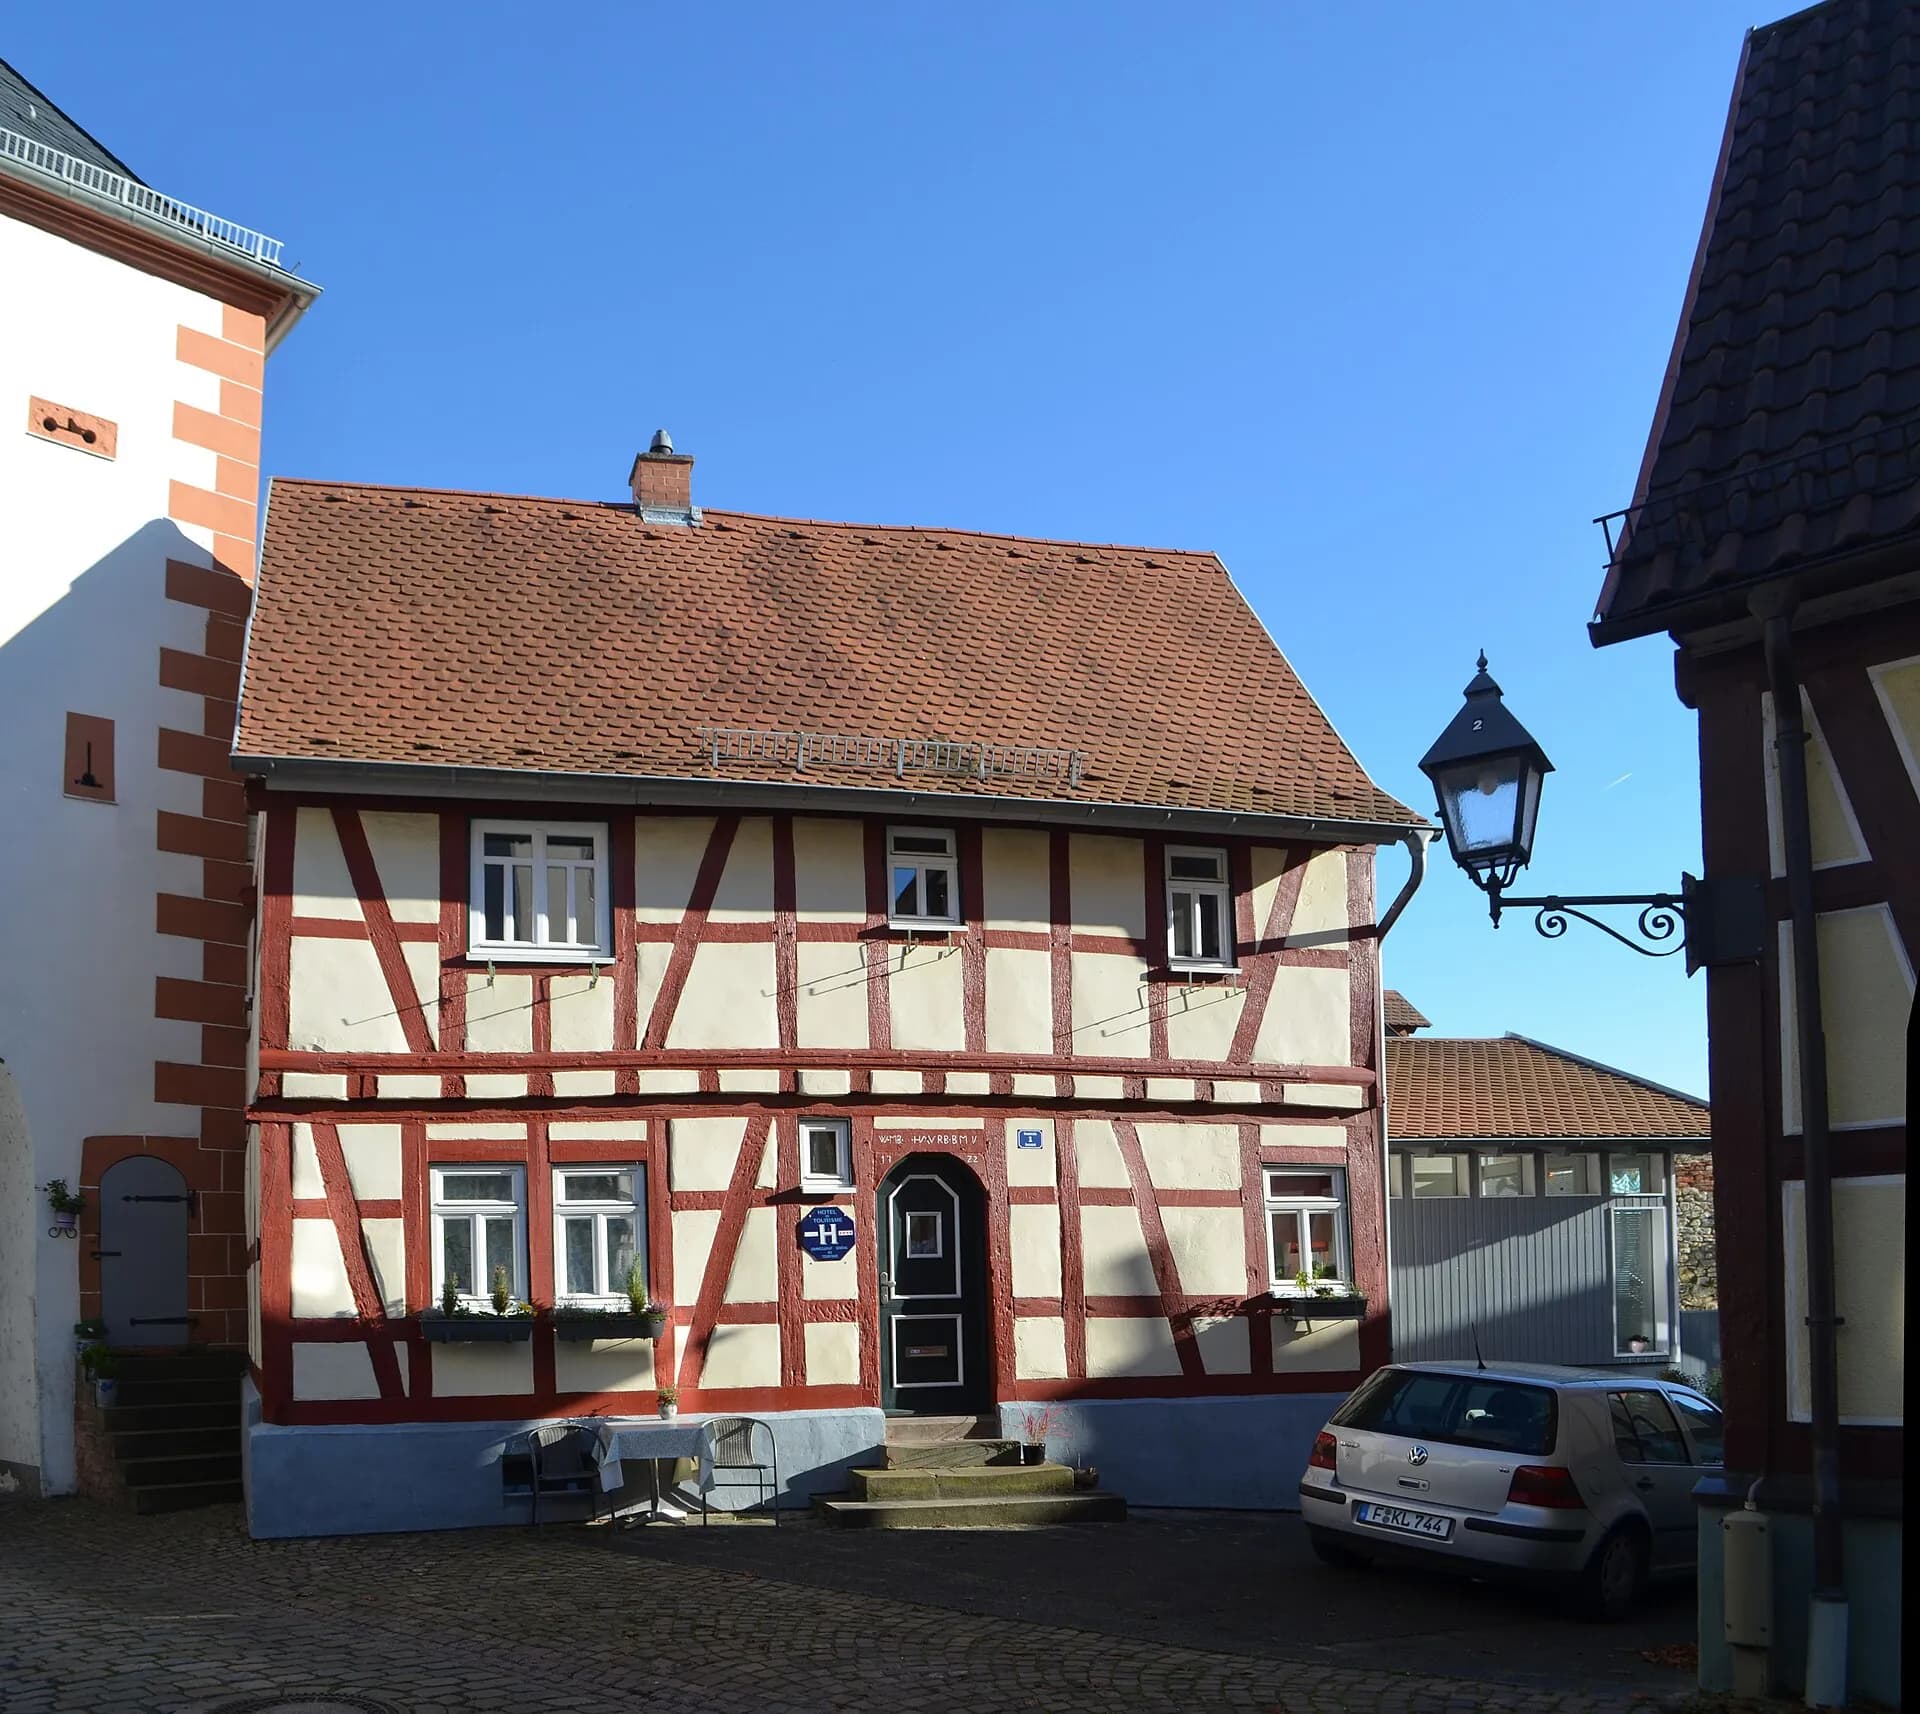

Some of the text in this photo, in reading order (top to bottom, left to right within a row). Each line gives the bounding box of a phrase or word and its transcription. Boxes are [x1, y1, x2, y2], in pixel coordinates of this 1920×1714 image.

[1472, 719, 1482, 731] 2
[819, 1223, 839, 1245] H
[1415, 1514, 1443, 1533] 744
